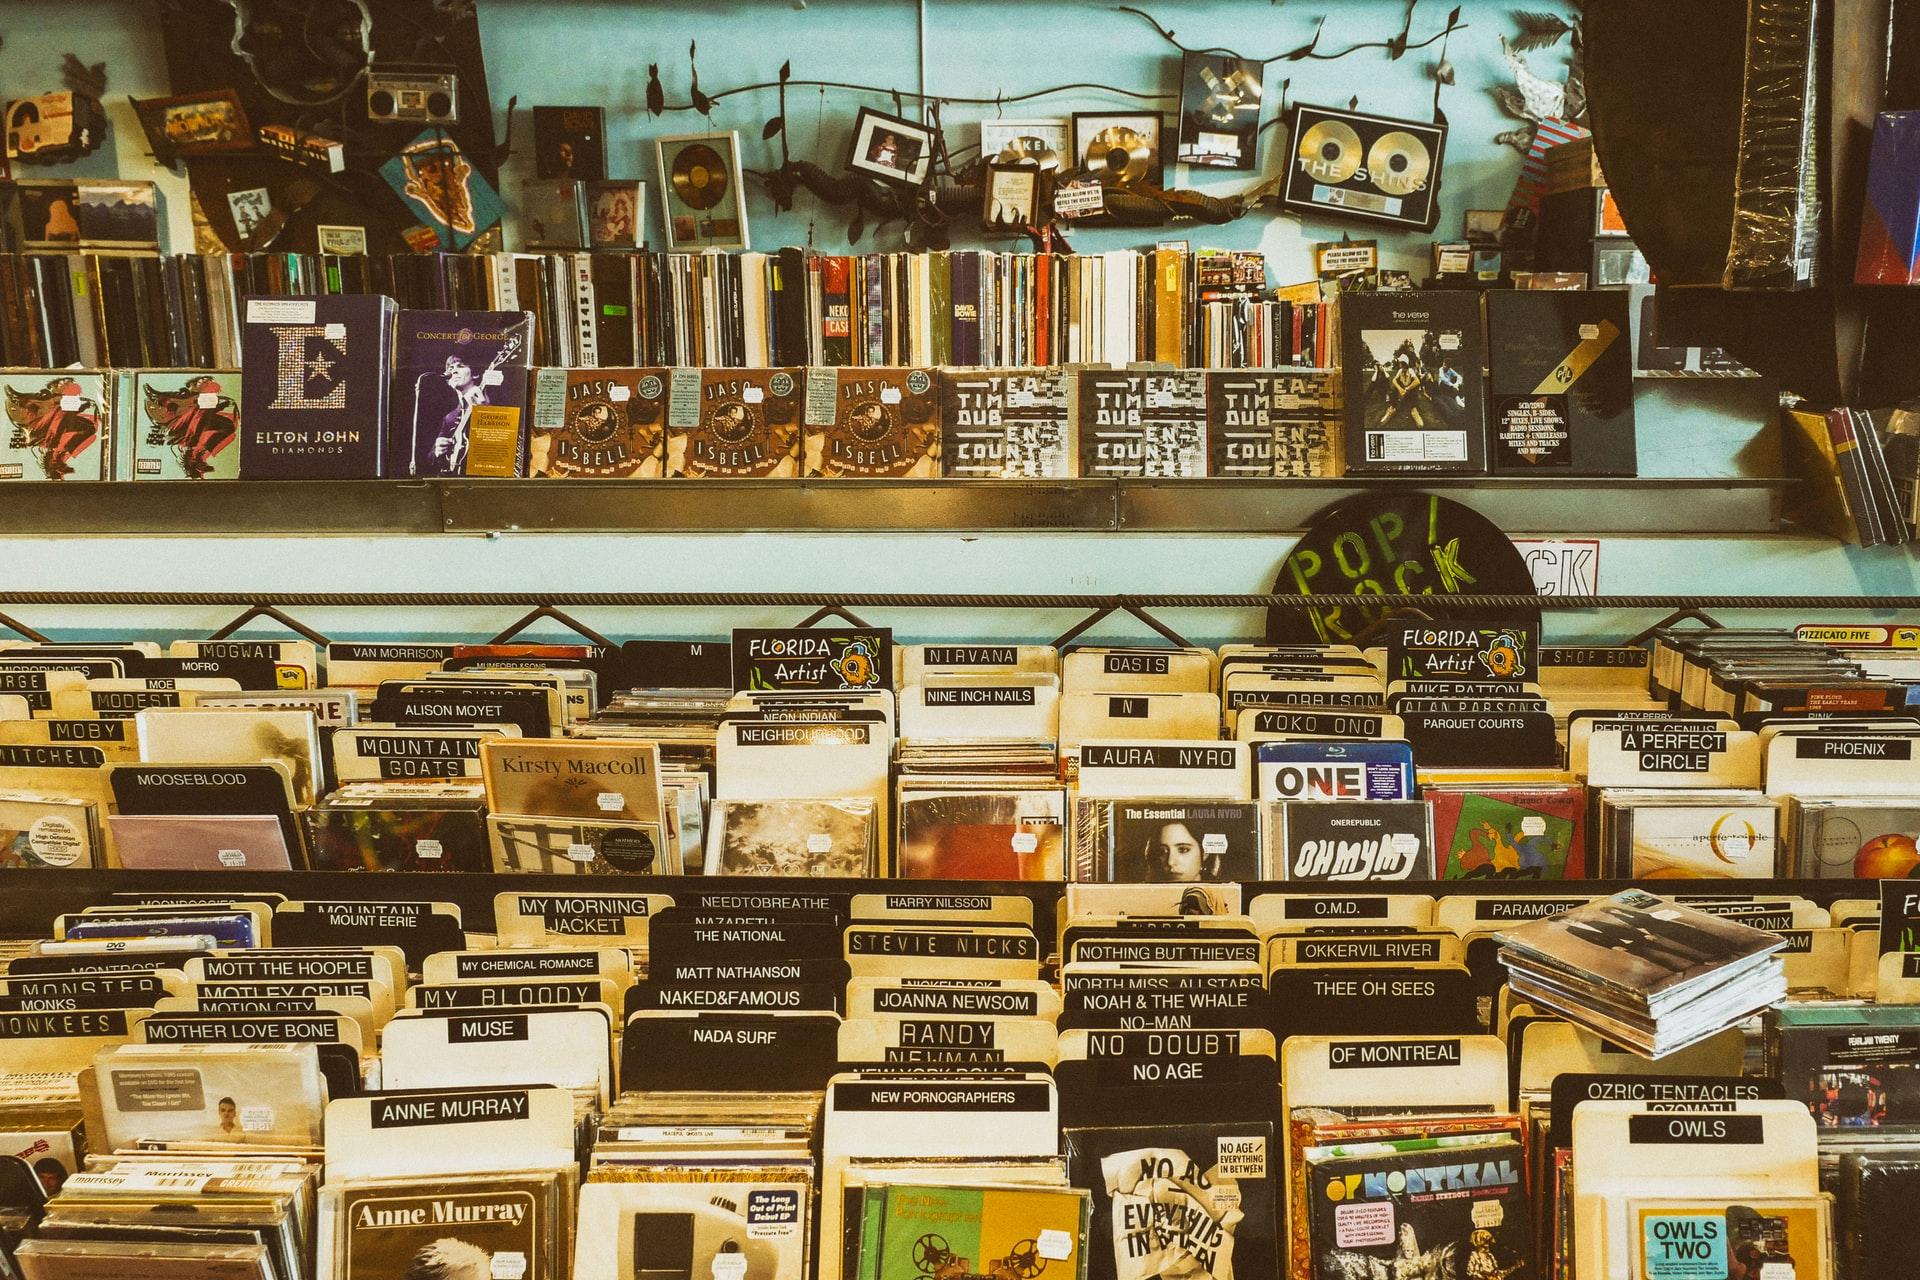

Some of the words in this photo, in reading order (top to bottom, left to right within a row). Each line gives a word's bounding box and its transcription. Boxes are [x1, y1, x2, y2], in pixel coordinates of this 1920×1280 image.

[1298, 158, 1342, 178] THE
[1354, 168, 1427, 191] SHINS
[954, 310, 977, 318] BOWIE
[957, 409, 1002, 425] DUB
[1096, 409, 1141, 425] DUB
[1225, 410, 1270, 426] DUB
[256, 431, 308, 443] ELTON
[314, 431, 360, 443] JOHN
[272, 446, 343, 454] DIAMONDS
[561, 442, 626, 466] ISBELL
[698, 442, 762, 466] ISBELL
[835, 440, 900, 465] ISBELL
[1403, 629, 1479, 647] FLORIDA
[1799, 631, 1848, 640] PIZZICATO
[1851, 631, 1870, 639] FIVE
[203, 645, 273, 658] MOGWAI
[353, 648, 377, 658] VAN
[380, 648, 444, 659] MORRISON
[691, 645, 702, 656] M
[750, 638, 831, 656] FLORIDA
[930, 649, 1014, 664] NIRVANA
[1425, 653, 1475, 671] Artist
[1553, 650, 1596, 664] SHOP
[1607, 650, 1648, 665] BOYS
[182, 662, 219, 672] MOFRO
[774, 662, 828, 680] Artist
[1109, 657, 1166, 673] OASIS
[150, 680, 174, 689] MOE
[97, 694, 173, 708] MODEST
[927, 690, 957, 703] NINE
[960, 690, 991, 703] INCH
[994, 690, 1032, 703] NAILS
[405, 705, 453, 716] ALISON
[456, 705, 503, 716] MOYET
[1122, 699, 1134, 715] N
[56, 723, 115, 738] MOBY
[1263, 715, 1317, 732] YOKO
[1334, 718, 1375, 735] ONO
[1424, 718, 1477, 730] PARQUET
[1478, 718, 1524, 729] COURTS
[362, 739, 479, 756] MOUNTAIN
[1624, 734, 1636, 748] A
[1642, 734, 1725, 749] PERFECT
[1825, 743, 1886, 755] PHOENIX
[1088, 749, 1155, 765] LAURA
[1179, 750, 1233, 767] NYRO
[1641, 754, 1707, 770] CIRCLE
[389, 761, 459, 777] GOATS
[502, 756, 562, 779] Kirsty
[568, 756, 646, 775] MacColl
[138, 773, 246, 786] MOOSEBLOOD
[1275, 767, 1361, 797] ONE
[1125, 808, 1143, 819] The
[1144, 808, 1185, 819] Essential
[1187, 808, 1216, 819] LAURA
[1330, 819, 1382, 827] ONEREPUBLIC
[521, 899, 546, 914] MY
[555, 899, 646, 915] MORNING
[702, 897, 830, 909] NEEDTOBREATHE
[890, 897, 932, 909] HARRY
[935, 897, 989, 909] NILSSON
[1315, 902, 1360, 914] O.M.D.
[330, 914, 377, 926] MOUNT
[379, 915, 417, 927] EERIE
[549, 917, 620, 933] JACKET
[694, 930, 719, 942] THE
[723, 930, 786, 942] NATIONAL
[106, 942, 126, 950] DVD
[853, 934, 937, 953] STEVIE
[957, 937, 1028, 956] NICKS
[1305, 945, 1382, 957] OKKERVIL
[1386, 944, 1432, 956] RIVER
[1080, 946, 1150, 960] NOTHING
[1155, 947, 1186, 960] BUT
[1190, 947, 1256, 961] THIEVES
[208, 962, 255, 976] MOTT
[260, 962, 293, 976] THE
[298, 961, 367, 976] HOOPLE
[462, 962, 479, 971] MY
[481, 960, 536, 971] CHEMICAL
[539, 958, 594, 970] ROMANCE
[676, 967, 713, 979] MATT
[716, 966, 800, 979] NATHANSON
[1314, 981, 1358, 996] THEE
[1362, 981, 1388, 996] OH
[1391, 981, 1435, 996] SEES
[424, 990, 458, 1008] MY
[482, 986, 590, 1006] BLOODY
[659, 990, 800, 1005] NAKED&FAMOUS
[880, 993, 947, 1008] JOANNA
[953, 994, 1029, 1010] NEWSOM
[1083, 995, 1131, 1010] NOAH
[1136, 995, 1147, 1009] &
[1151, 995, 1184, 1009] THE
[1190, 993, 1248, 1008] WHALE
[21, 999, 77, 1011] MONKS
[149, 1025, 226, 1038] MOTHER
[231, 1024, 280, 1038] LOVE
[285, 1023, 336, 1038] BONE
[461, 1021, 514, 1037] MUSE
[693, 1029, 733, 1043] NADA
[737, 1030, 777, 1044] SURF
[902, 1023, 991, 1044] RANDY
[1091, 1035, 1125, 1056] NO
[1149, 1034, 1238, 1055] DOUBT
[1331, 1048, 1355, 1063] OF
[1361, 1045, 1459, 1062] MONTREAL
[1133, 1065, 1162, 1080] NO
[1165, 1063, 1203, 1079] AGE
[871, 1092, 900, 1103] NEW
[903, 1092, 1016, 1104] PORNOGRAPHERS
[1588, 1083, 1645, 1100] OZRIC
[1650, 1085, 1760, 1101] TENTACLES
[382, 1103, 435, 1121] ANNE
[441, 1097, 525, 1117] MURRAY
[1668, 1120, 1727, 1138] OWLS
[1221, 1143, 1233, 1153] NO
[1236, 1143, 1253, 1153] AGE
[1220, 1155, 1263, 1164] EVERYTHING
[1220, 1165, 1228, 1173] IN
[1229, 1164, 1263, 1174] BETWEEN
[771, 1196, 791, 1204] Long
[356, 1205, 426, 1228] Anne
[431, 1200, 529, 1226] Murray
[765, 1204, 775, 1212] of
[1654, 1221, 1718, 1240] OWLS
[1660, 1241, 1712, 1260] TWO
